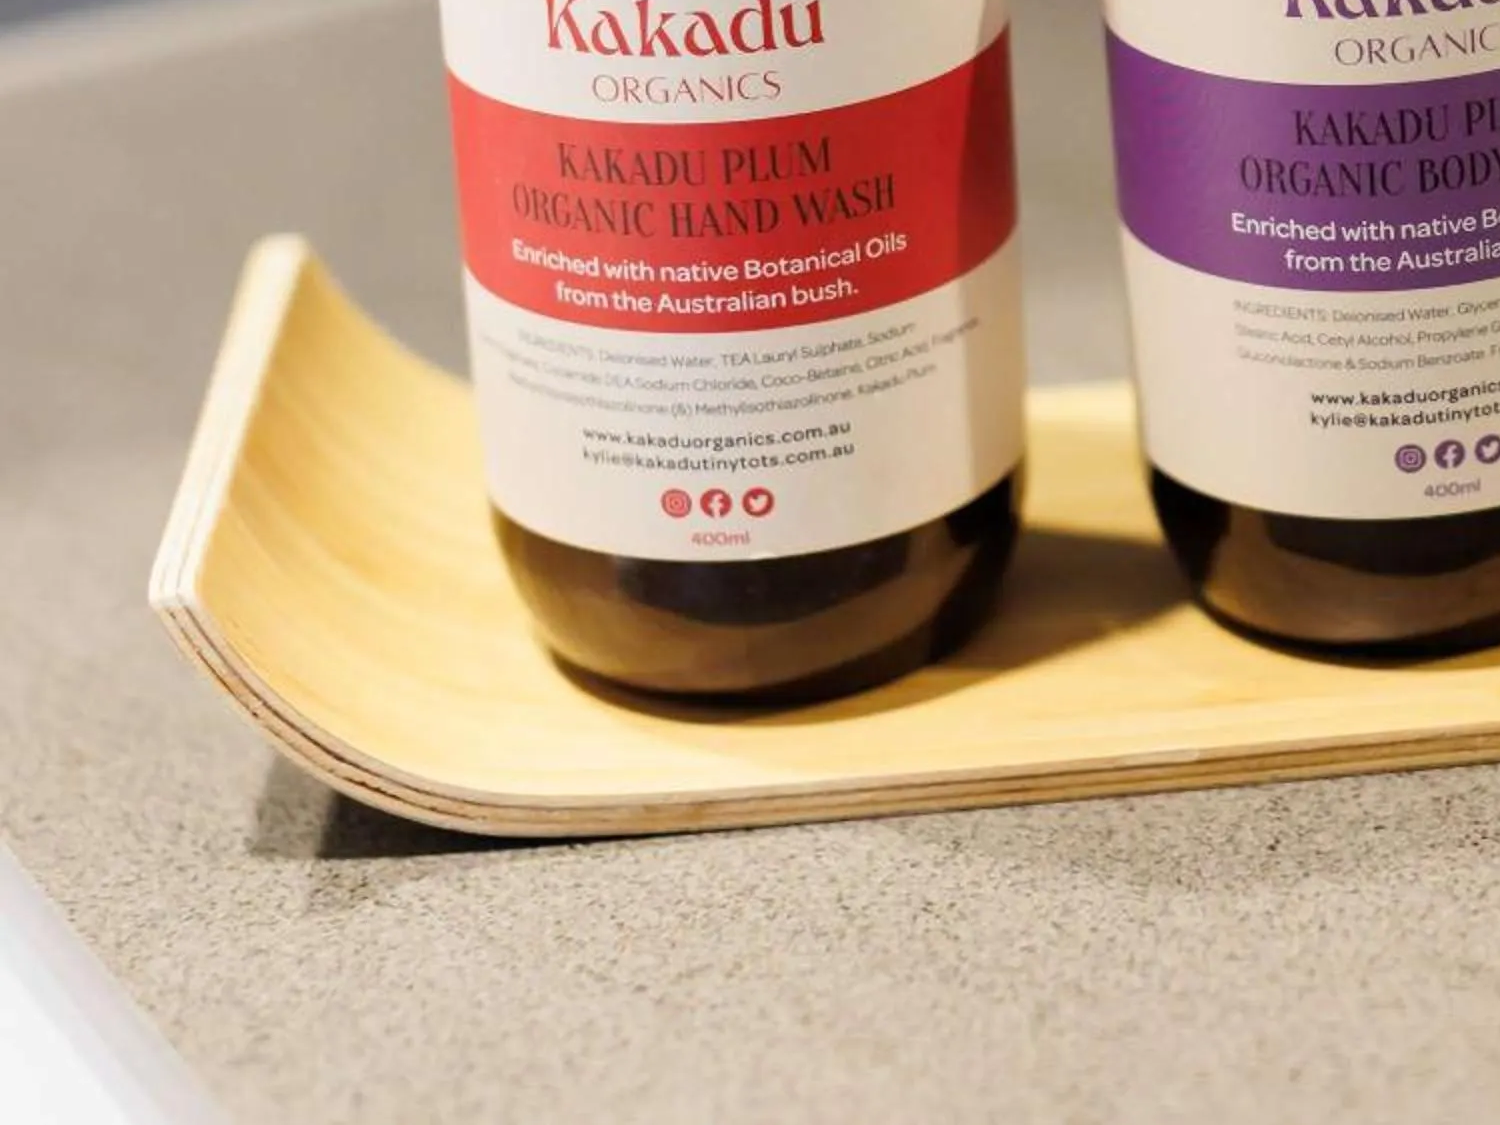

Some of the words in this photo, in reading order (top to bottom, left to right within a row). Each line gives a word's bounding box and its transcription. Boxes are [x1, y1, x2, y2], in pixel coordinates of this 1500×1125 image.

[591, 70, 782, 104] ORGANICS
[1294, 104, 1450, 148] KAKADU
[556, 141, 707, 187] KAKADU
[722, 136, 831, 185] PLUM
[1240, 156, 1406, 198] ORGANIC
[512, 182, 655, 239] ORGANIC
[670, 194, 780, 239] HAND
[794, 173, 896, 223] WASH
[1232, 212, 1336, 242] Enriched
[1341, 218, 1396, 243] with
[1400, 211, 1477, 241] native
[512, 239, 601, 280] Enriched
[604, 258, 658, 284] with
[660, 259, 739, 284] native
[744, 242, 862, 280] Botanical
[865, 230, 907, 259] Oils
[1284, 249, 1343, 274] from
[1344, 250, 1392, 274] the
[555, 281, 608, 311] from
[612, 288, 653, 314] the
[656, 285, 788, 314] Australian
[792, 275, 859, 305] bush.
[721, 351, 751, 367] TEA
[1358, 356, 1415, 372] Sodium
[583, 419, 852, 452] www.kakaduorganics.com.au
[583, 442, 855, 473] kylie@kakadutinytots.com.au
[1423, 478, 1482, 499] 400ml
[692, 529, 751, 547] 400ml
